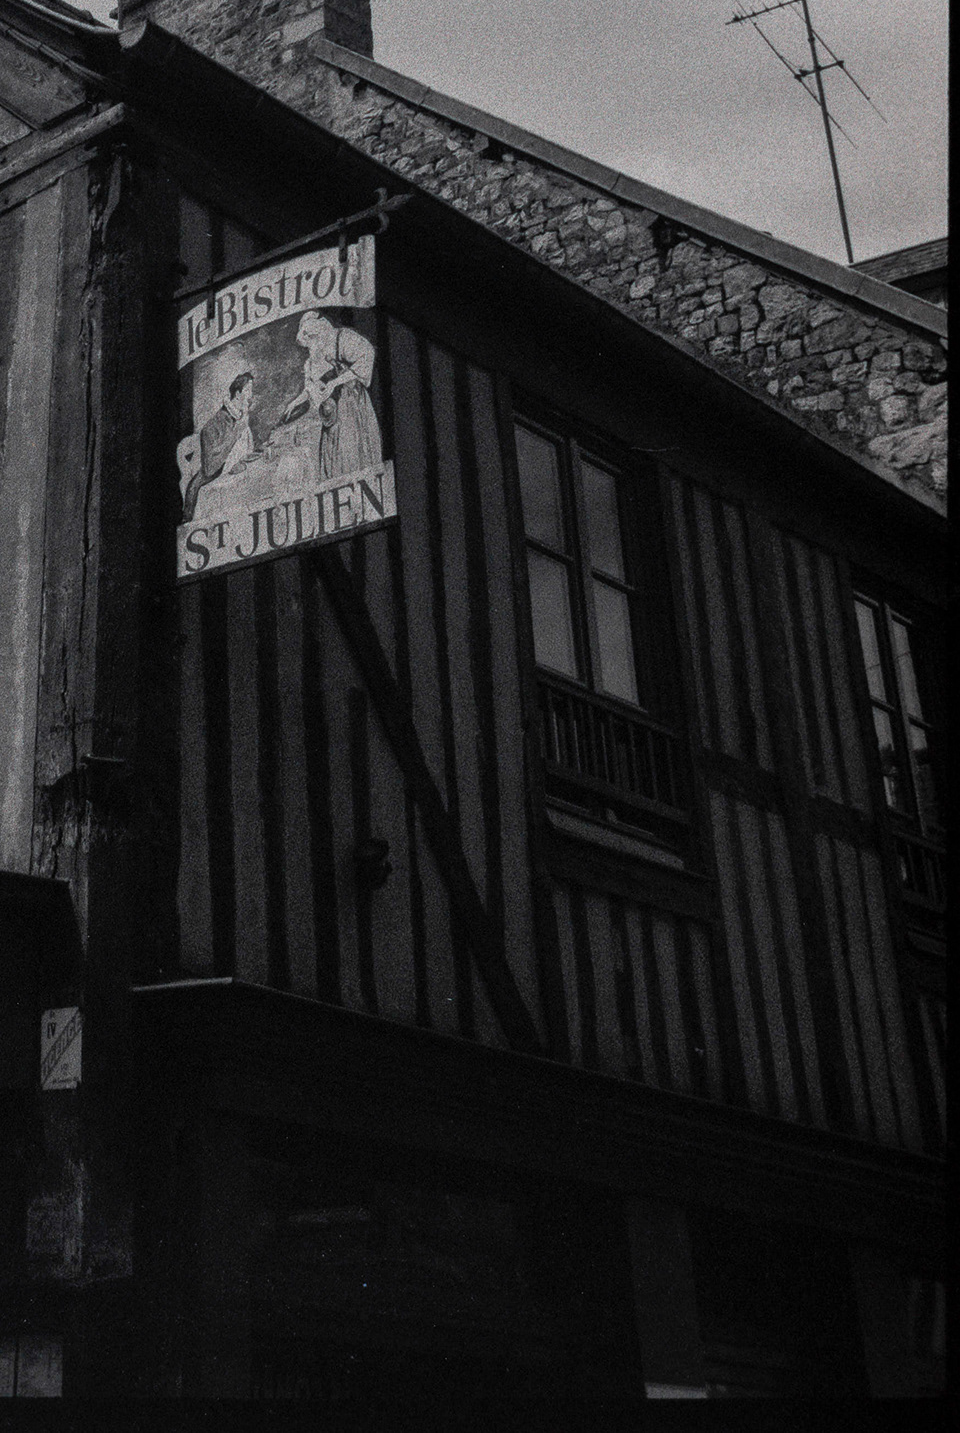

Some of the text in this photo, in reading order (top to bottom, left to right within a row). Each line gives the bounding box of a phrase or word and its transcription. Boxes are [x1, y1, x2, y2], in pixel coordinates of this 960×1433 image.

[186, 257, 352, 356] le Bistrot
[235, 473, 385, 558] JULIEN
